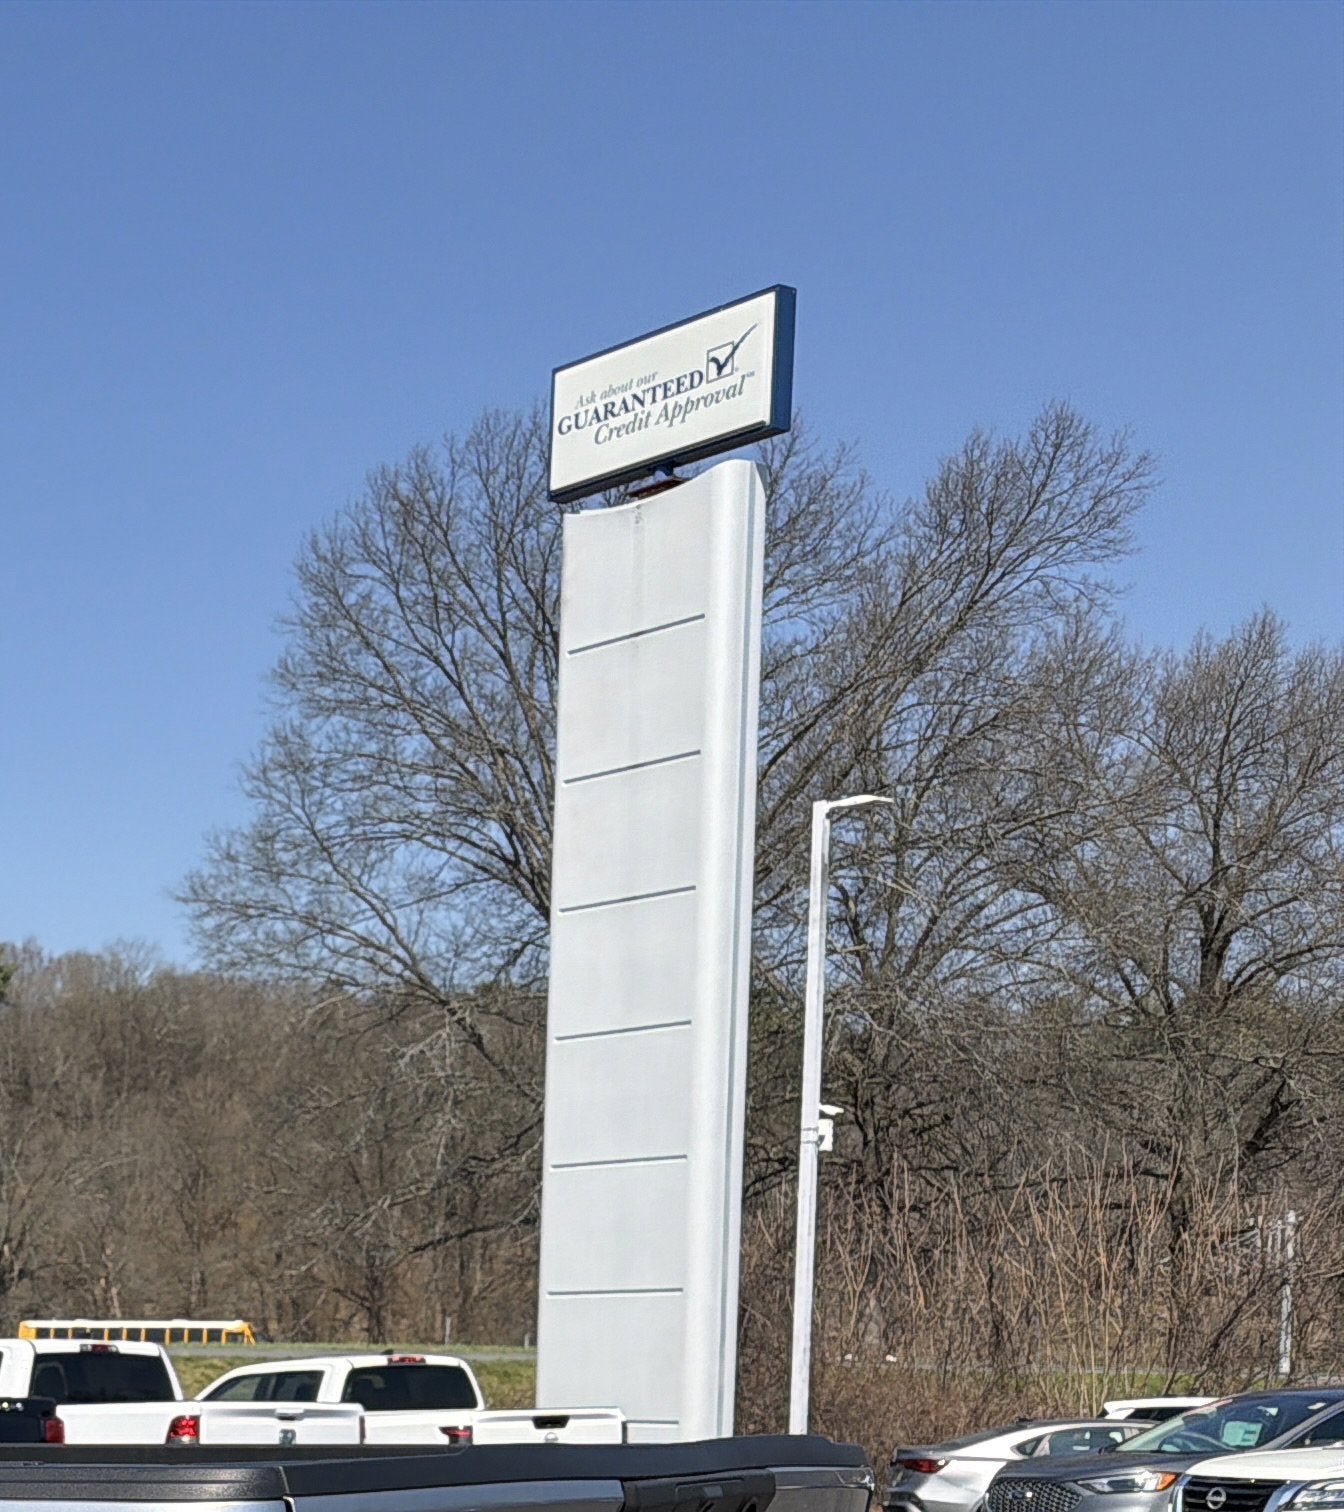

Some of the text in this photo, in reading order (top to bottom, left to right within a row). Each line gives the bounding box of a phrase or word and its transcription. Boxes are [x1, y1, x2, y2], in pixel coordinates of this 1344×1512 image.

[557, 369, 704, 436] GUARANTEED
[575, 371, 658, 409] Ask about our
[594, 374, 746, 445] Credit Approval
